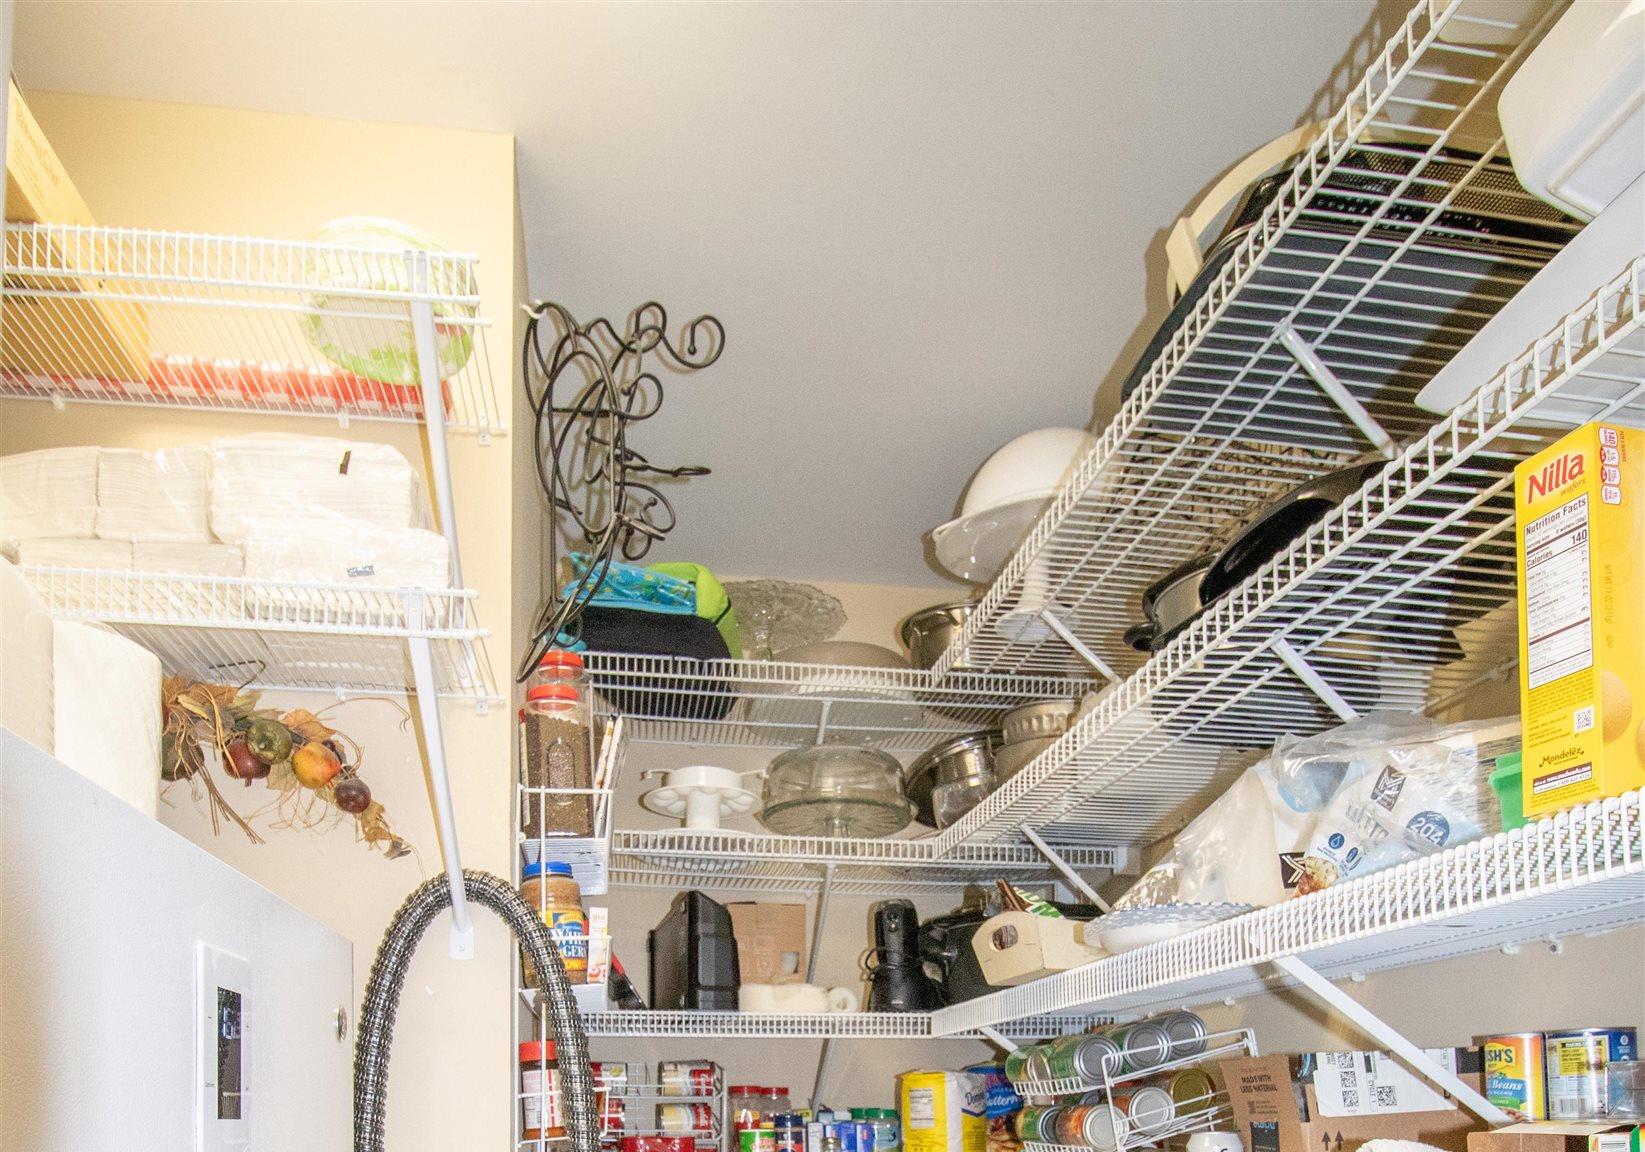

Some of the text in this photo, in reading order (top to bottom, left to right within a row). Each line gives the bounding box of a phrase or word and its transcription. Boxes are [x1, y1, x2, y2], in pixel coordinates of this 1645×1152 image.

[1528, 453, 1585, 505] Nilla
[1526, 498, 1587, 536] Nutrition Facts
[1526, 529, 1588, 568] Calories 140
[1488, 1049, 1513, 1063] SH'S
[1492, 1080, 1523, 1091] Beans
